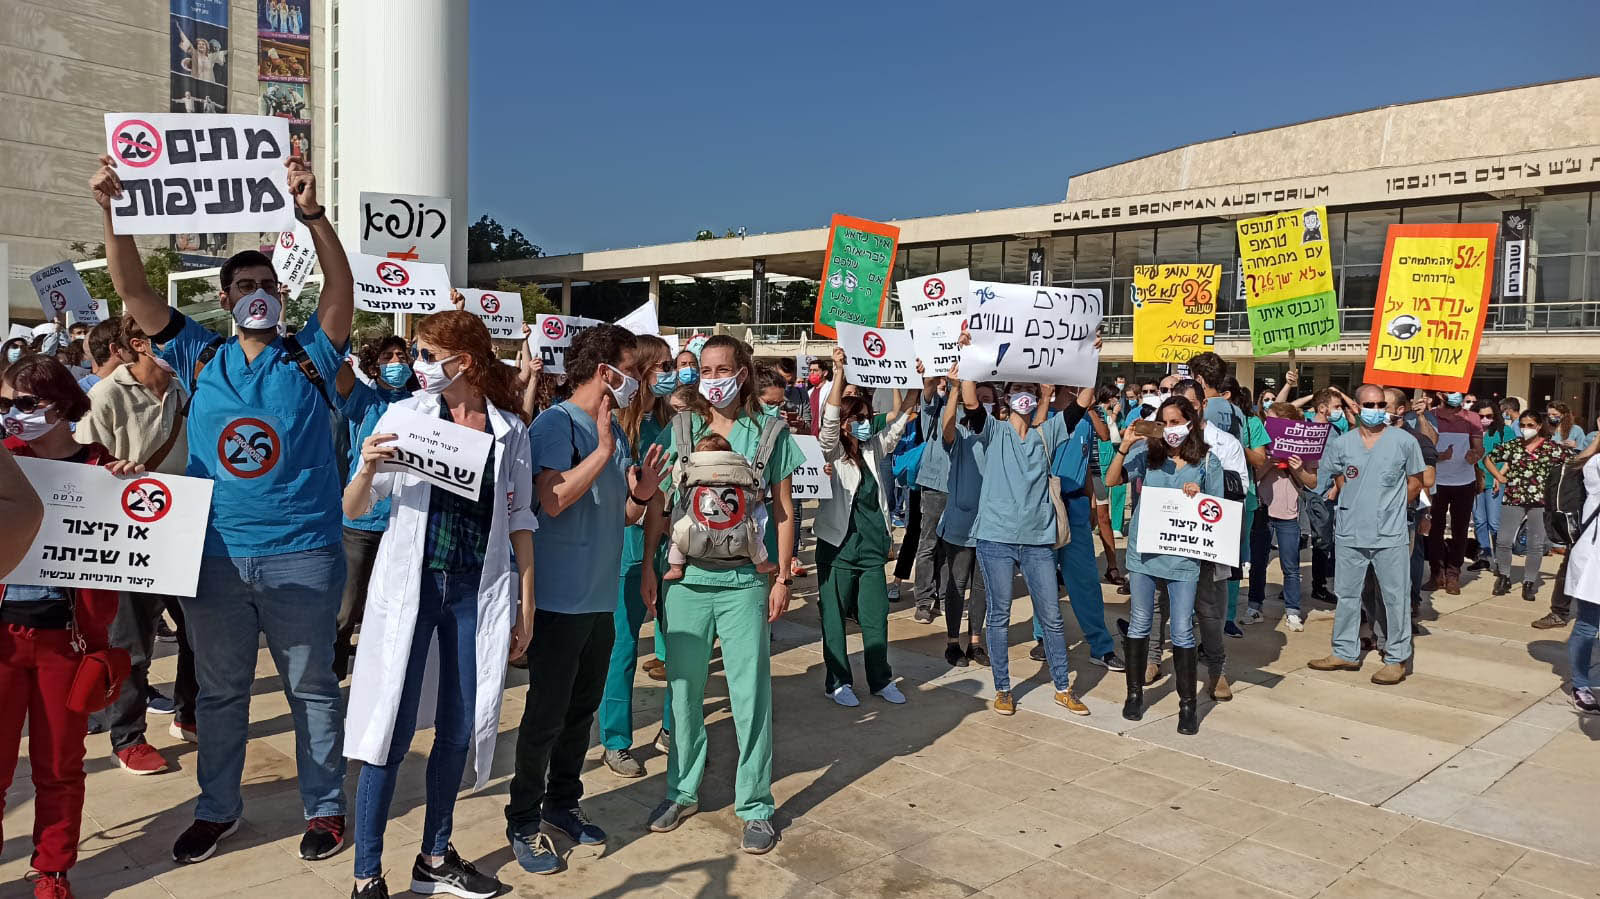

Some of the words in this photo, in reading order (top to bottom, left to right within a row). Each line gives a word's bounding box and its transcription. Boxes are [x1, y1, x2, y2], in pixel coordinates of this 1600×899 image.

[118, 131, 152, 159] 26
[165, 127, 282, 166] מתים
[1386, 170, 1468, 195] ברונפמן
[1053, 206, 1121, 223] CHARLES
[1128, 196, 1217, 217] BRONFMAN
[1221, 184, 1330, 208] AUDITORIUM
[363, 198, 447, 241] רופא
[1276, 215, 1299, 230] היית
[1240, 220, 1273, 235] תופס
[845, 229, 869, 242] נדאג
[873, 236, 891, 249] איך
[1249, 233, 1287, 252] טרמפ
[844, 245, 887, 264] לבריאות
[1305, 245, 1323, 259] עם
[1454, 245, 1485, 270] 52%
[833, 256, 859, 269] שלכם
[1247, 251, 1298, 270] מתמחה
[382, 265, 405, 282] 26
[1508, 244, 1521, 293] שוברים
[868, 273, 884, 285] אם
[1412, 273, 1456, 284] מדווחים
[356, 281, 393, 294] ייגמר
[397, 288, 416, 296] לא
[1181, 278, 1212, 306] 26
[362, 299, 413, 311] שתקצר
[830, 291, 853, 305] שלנו
[937, 298, 949, 307] לא
[951, 296, 962, 305] זה
[1033, 290, 1101, 316] החיים
[1384, 295, 1404, 314] על
[416, 301, 436, 311] עד
[911, 302, 935, 312] ייגמר
[1288, 297, 1325, 318] ונכנס
[491, 314, 503, 322] לא
[1257, 305, 1284, 322] איתו
[969, 312, 1014, 334] שווים
[1025, 318, 1089, 341] שלכם
[501, 328, 513, 336] עד
[851, 356, 876, 367] ייגמר
[1022, 347, 1064, 369] יותר
[1429, 347, 1463, 365] אחרי
[879, 359, 892, 369] לא
[894, 360, 907, 369] זה
[857, 373, 891, 385] שתקצר
[893, 376, 908, 384] עד
[408, 432, 438, 447] תורנויות
[432, 429, 441, 437] או
[227, 431, 272, 464] 26
[441, 442, 459, 453] קיצור
[807, 467, 819, 476] זה
[806, 484, 819, 493] עד
[128, 489, 164, 512] 26
[62, 518, 119, 542] קיצור
[1169, 518, 1198, 531] קיצור
[1202, 523, 1213, 533] או
[127, 525, 150, 540] או
[1160, 532, 1199, 544] שביתה
[1203, 538, 1215, 548] או
[42, 545, 120, 565] שביתה
[128, 551, 151, 568] או
[39, 568, 76, 580] עכשיו!
[79, 572, 122, 584] תורנויות
[127, 576, 155, 588] קיצור
